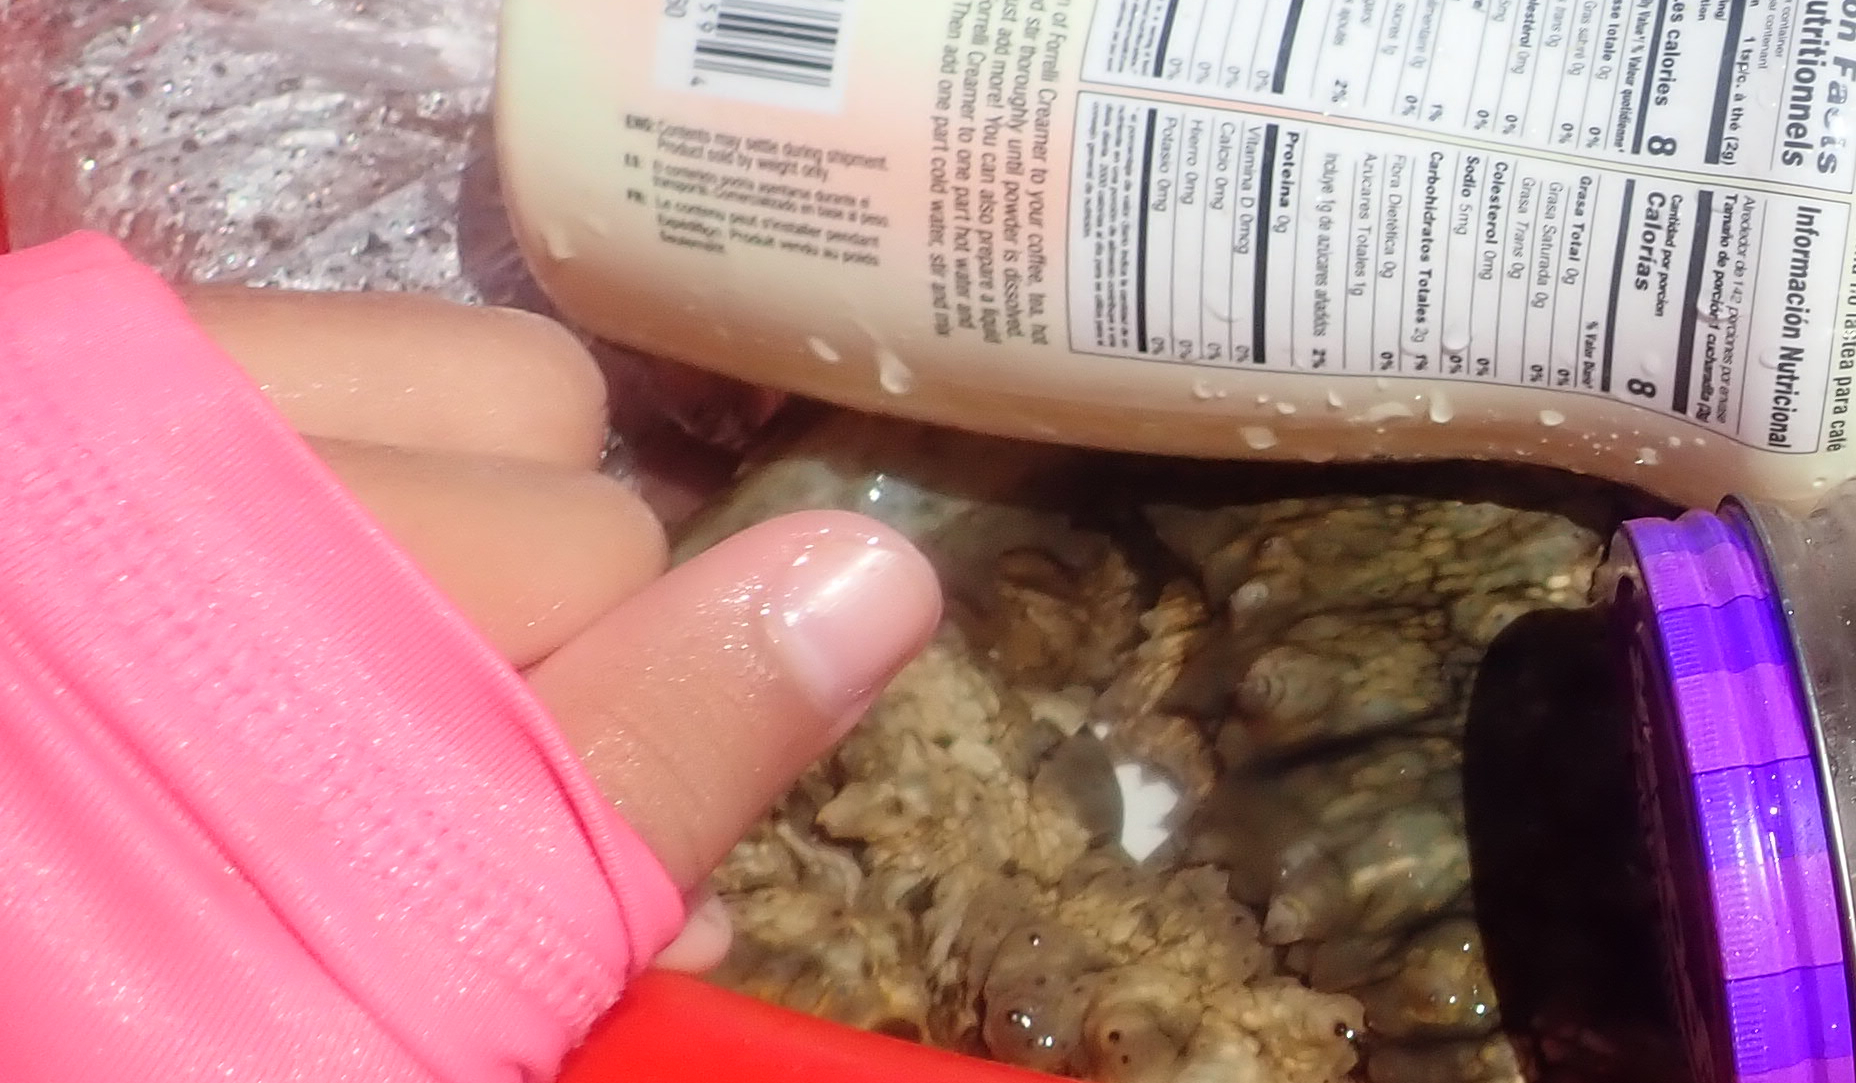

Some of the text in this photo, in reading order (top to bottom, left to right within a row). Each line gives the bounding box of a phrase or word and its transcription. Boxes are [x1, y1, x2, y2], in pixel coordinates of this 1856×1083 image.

[1050, 11, 1070, 29] of
[1742, 34, 1755, 43] 1
[960, 49, 985, 120] Creamer
[1654, 28, 1684, 107] calories
[937, 79, 955, 111] one
[1401, 94, 1419, 117] 0%
[930, 115, 951, 151] part
[958, 125, 976, 144] to
[982, 113, 1001, 147] You
[1032, 87, 1057, 161] Creamer
[1473, 108, 1488, 130] 0%
[1501, 113, 1517, 135] 0%
[1585, 125, 1602, 148] 0%
[1646, 133, 1677, 158] 8
[1719, 136, 1739, 167] (2g)
[955, 148, 973, 182] one
[980, 151, 997, 185] can
[1241, 124, 1261, 191] Vitamina
[930, 156, 949, 195] cold
[1029, 166, 1048, 185] to
[1179, 170, 1198, 205] 0mg
[1026, 188, 1043, 228] your
[1151, 177, 1170, 212] 0mg
[1209, 176, 1228, 211] 0mg
[1241, 195, 1254, 208] D
[1419, 150, 1444, 263] Carbohidratos
[1453, 155, 1478, 236] Sodio 5mg
[1485, 161, 1507, 244] Colesterol
[1544, 181, 1561, 220] Grasa
[1574, 174, 1591, 216] Grasa
[1271, 214, 1289, 233] 0g
[1506, 176, 1534, 279] Grasa Trans 0g
[1567, 222, 1585, 261] Total
[1378, 259, 1395, 279] 0g
[1478, 249, 1496, 281] 0mg
[1561, 267, 1579, 286] 0g
[1416, 267, 1433, 325] Totales
[1768, 206, 1822, 447] Información Nutricional
[1625, 377, 1657, 399] 8
[1831, 375, 1851, 416] para
